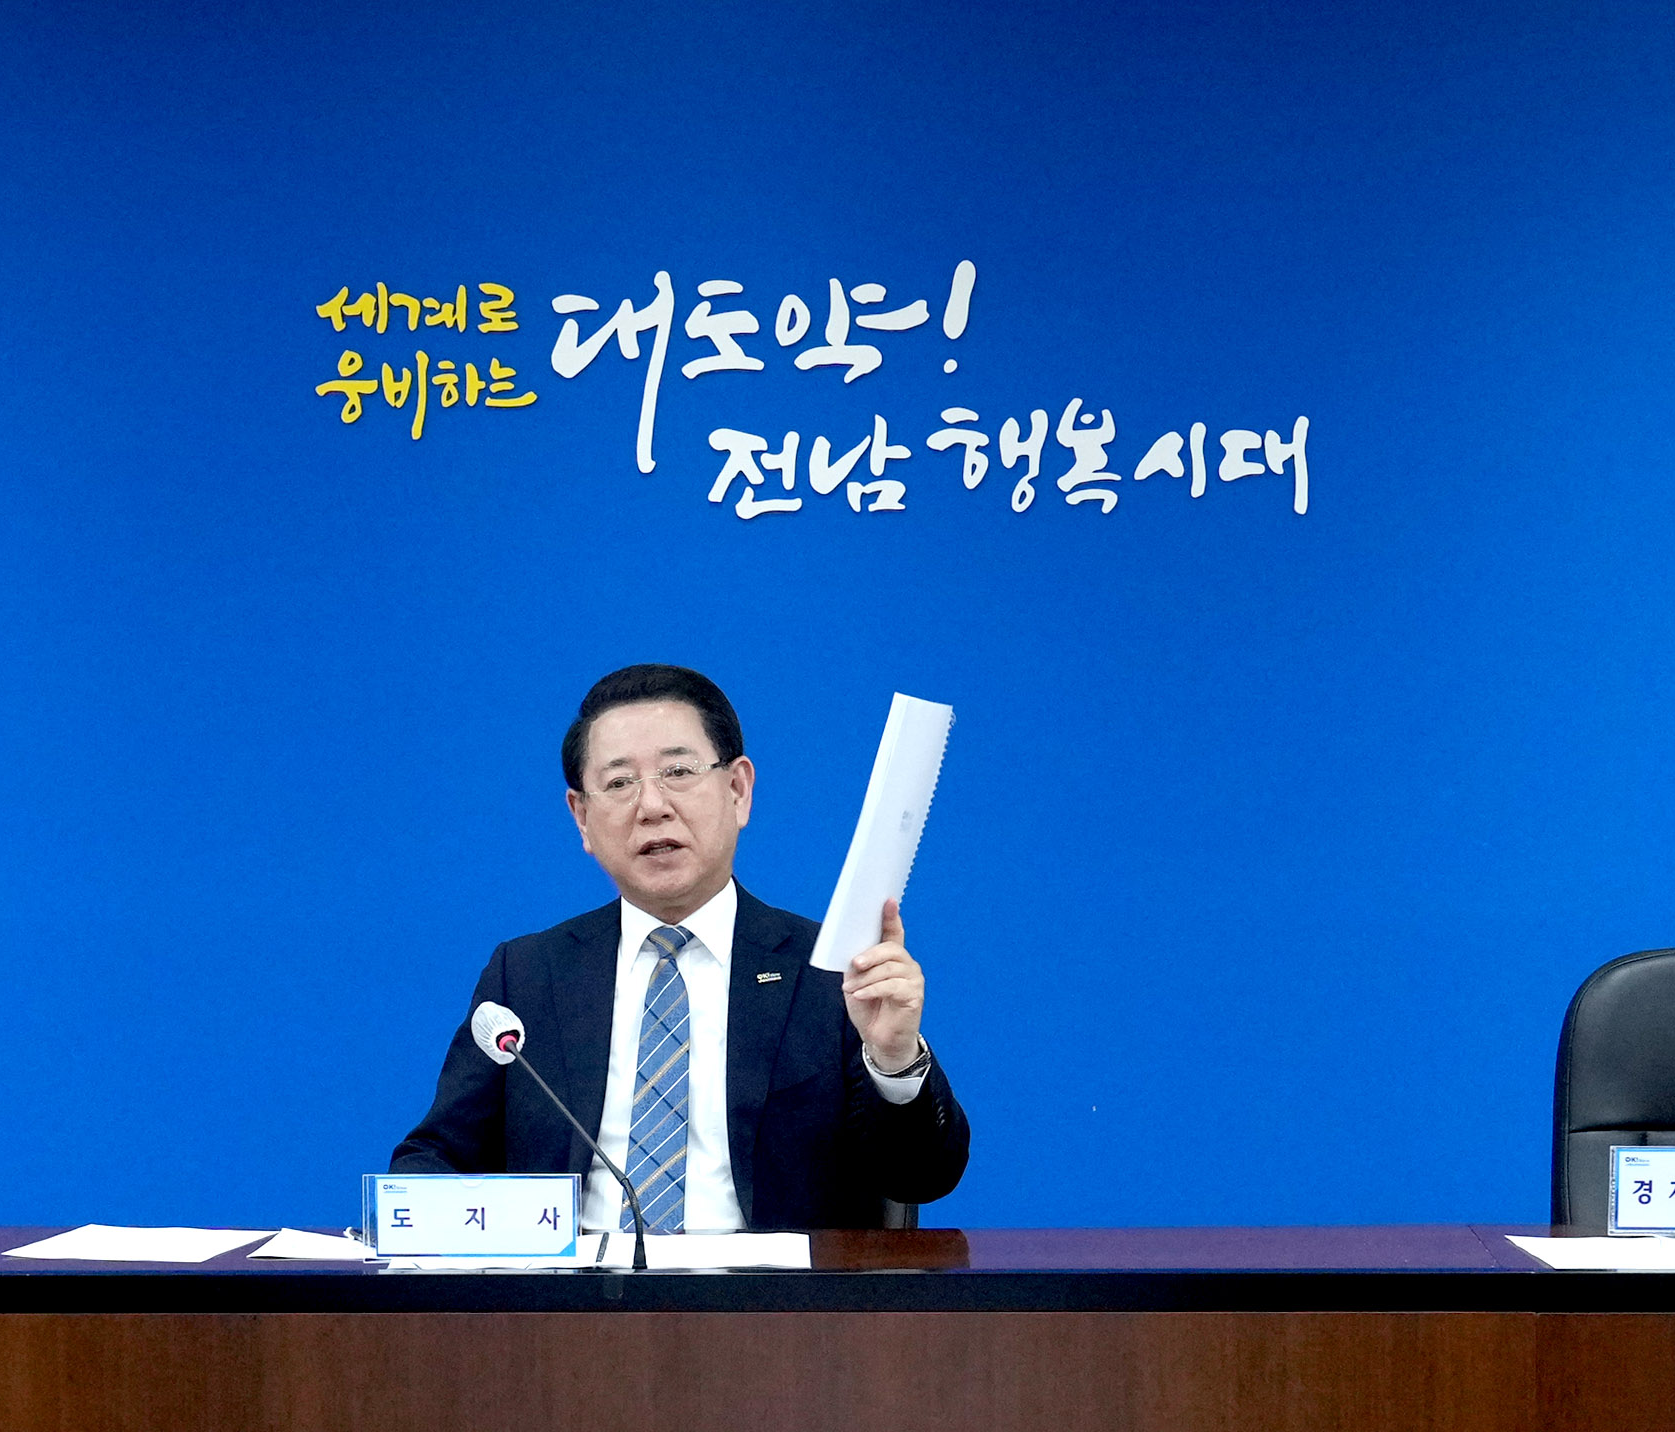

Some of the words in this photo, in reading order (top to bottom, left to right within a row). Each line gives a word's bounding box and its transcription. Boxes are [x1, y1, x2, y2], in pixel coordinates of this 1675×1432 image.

[315, 281, 519, 334] 세계로
[315, 349, 538, 440] 웅비하는
[552, 260, 976, 474] 대도약!
